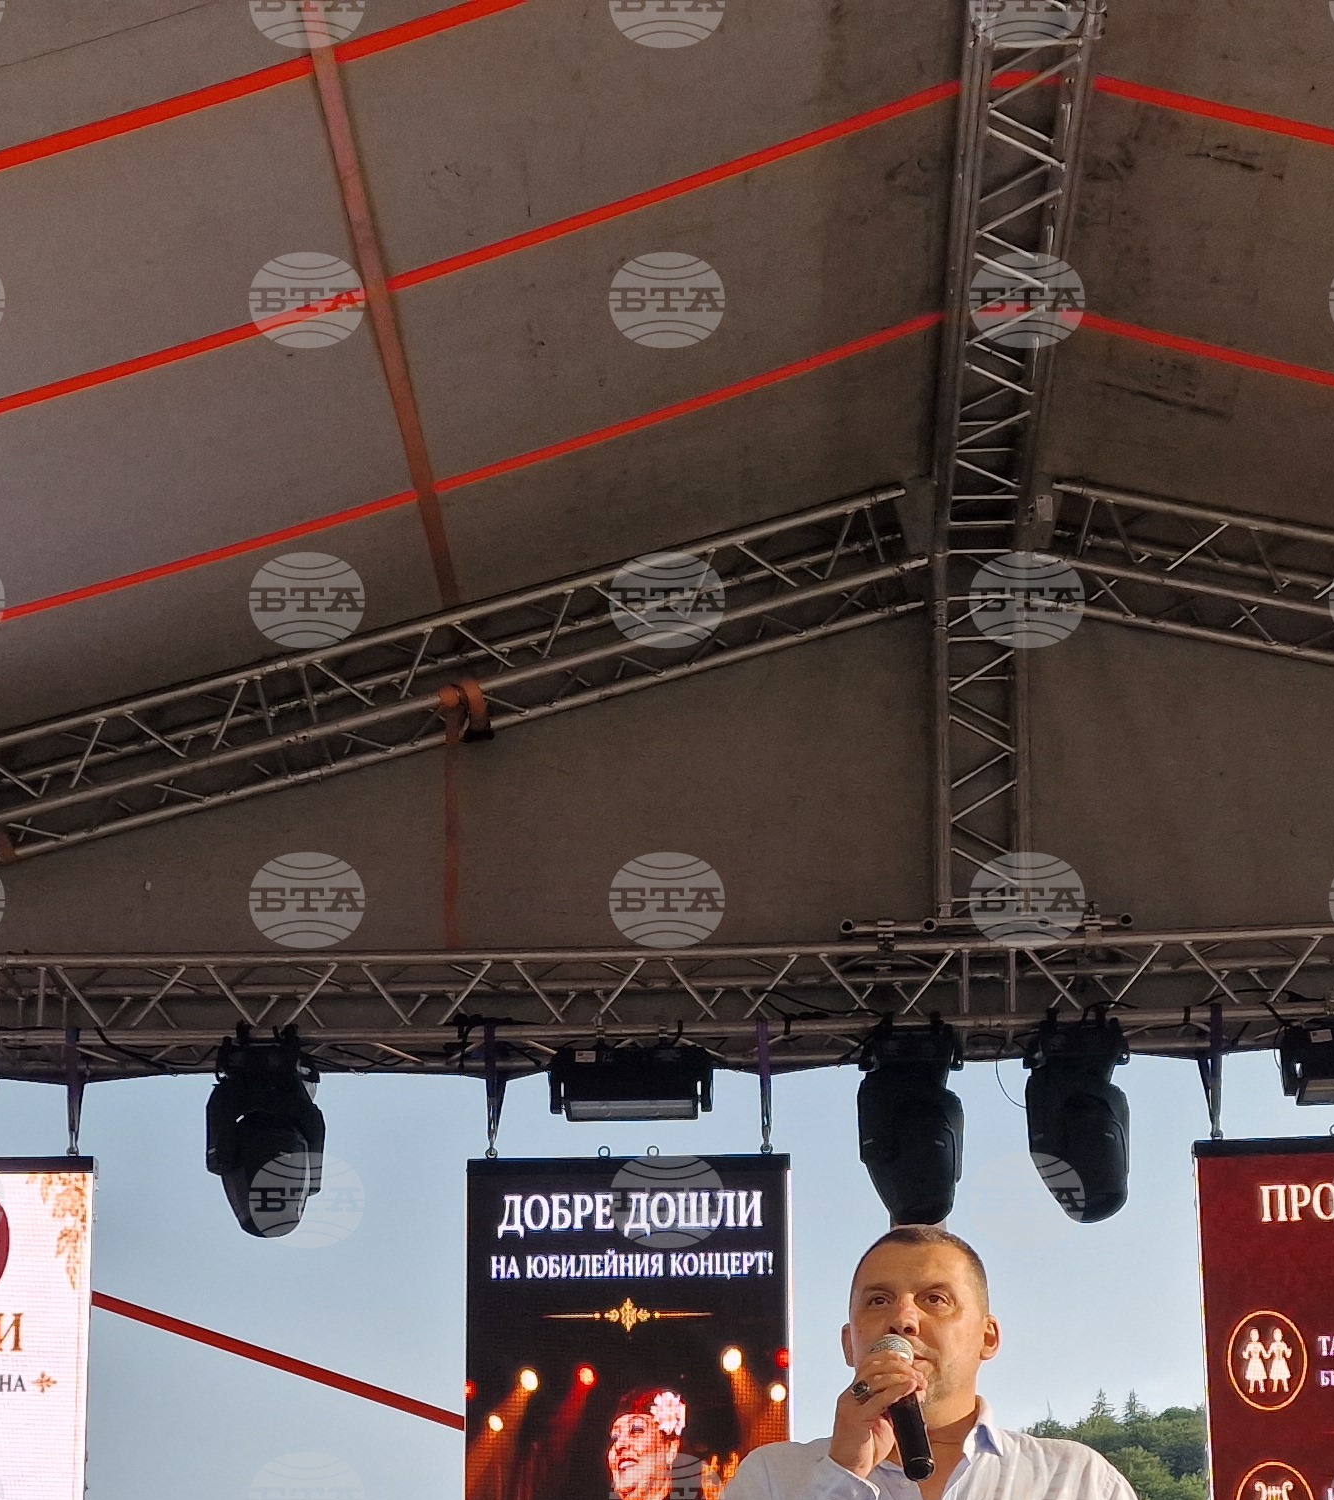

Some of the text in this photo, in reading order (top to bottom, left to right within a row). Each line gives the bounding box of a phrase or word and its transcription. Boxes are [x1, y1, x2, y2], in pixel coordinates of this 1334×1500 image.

[497, 1192, 615, 1239] ДОБРЕ
[623, 1190, 764, 1237] ДОШЛИ
[490, 1247, 775, 1280] НА ЮБИЛЕЙНИЯ КОНЦЕРТ!
